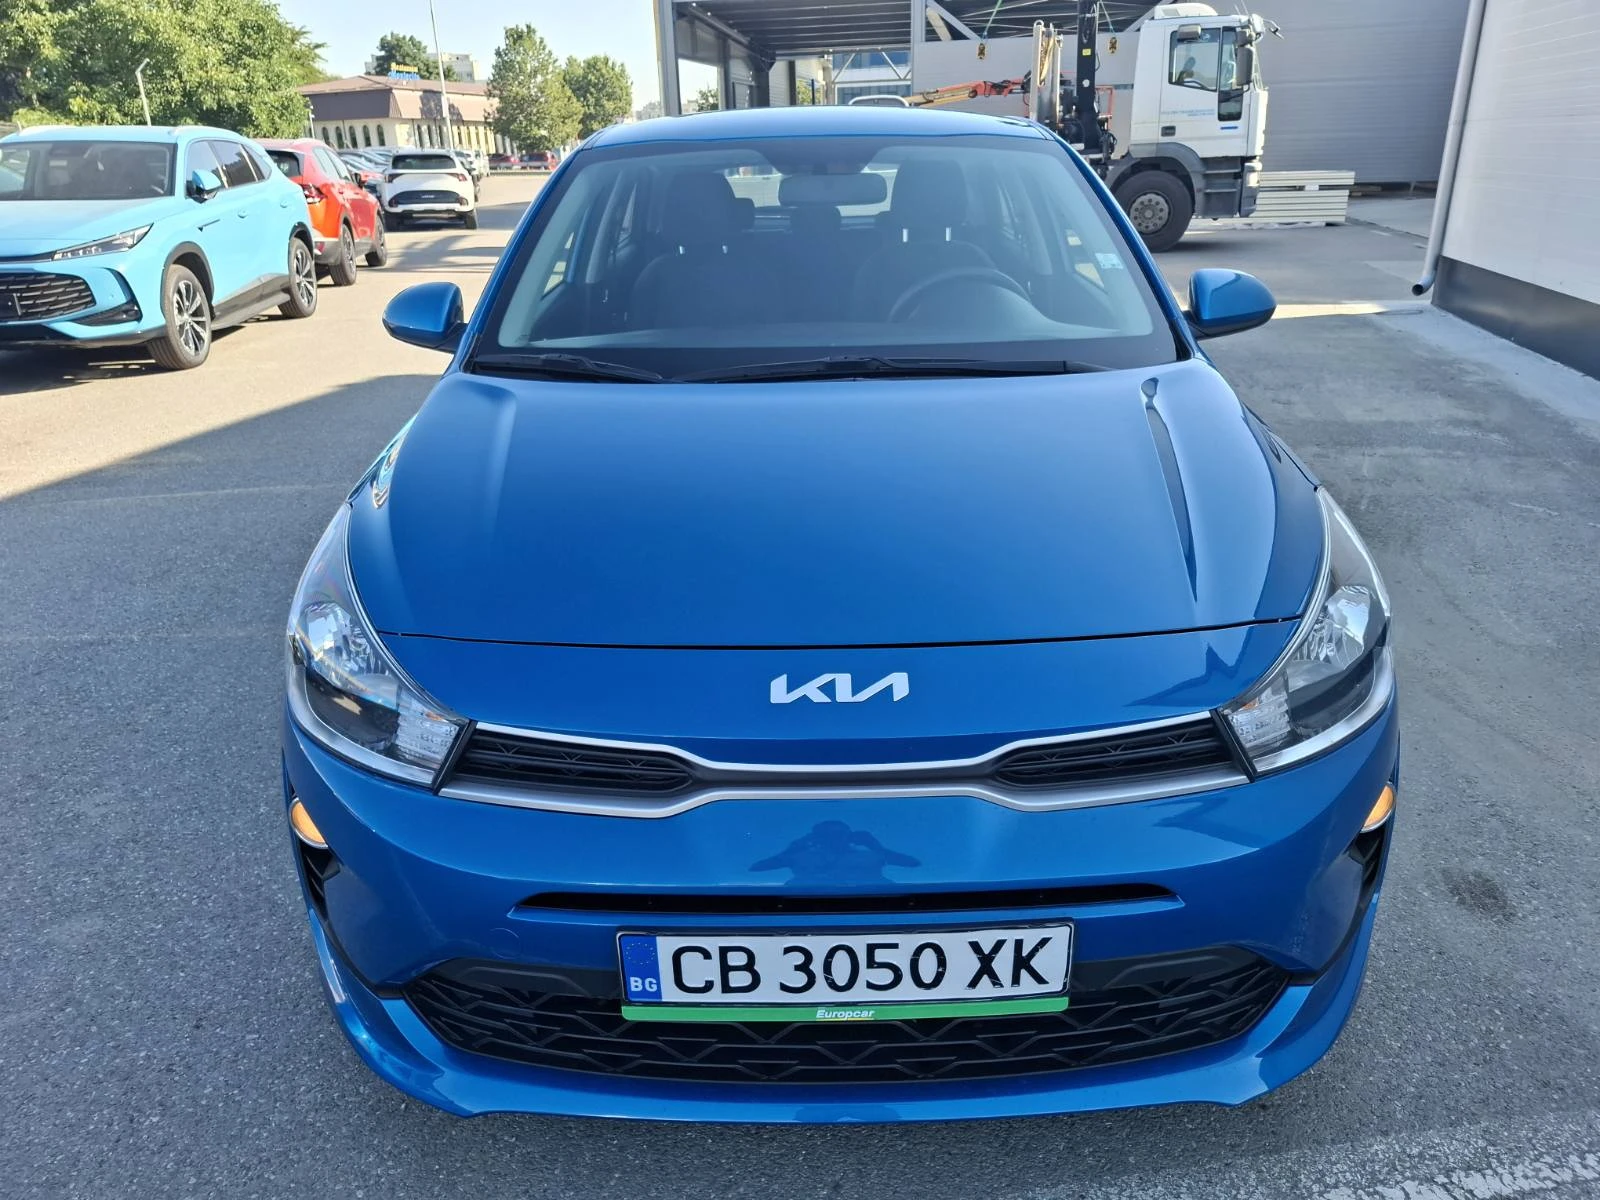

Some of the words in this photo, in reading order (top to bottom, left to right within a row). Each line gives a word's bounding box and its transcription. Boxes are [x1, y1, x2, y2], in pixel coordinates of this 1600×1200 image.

[770, 672, 910, 704] KIA
[672, 945, 762, 994] CB
[780, 942, 948, 994] 3050
[966, 936, 1053, 990] XK
[629, 976, 658, 993] BG
[815, 1008, 876, 1021] Europcar
